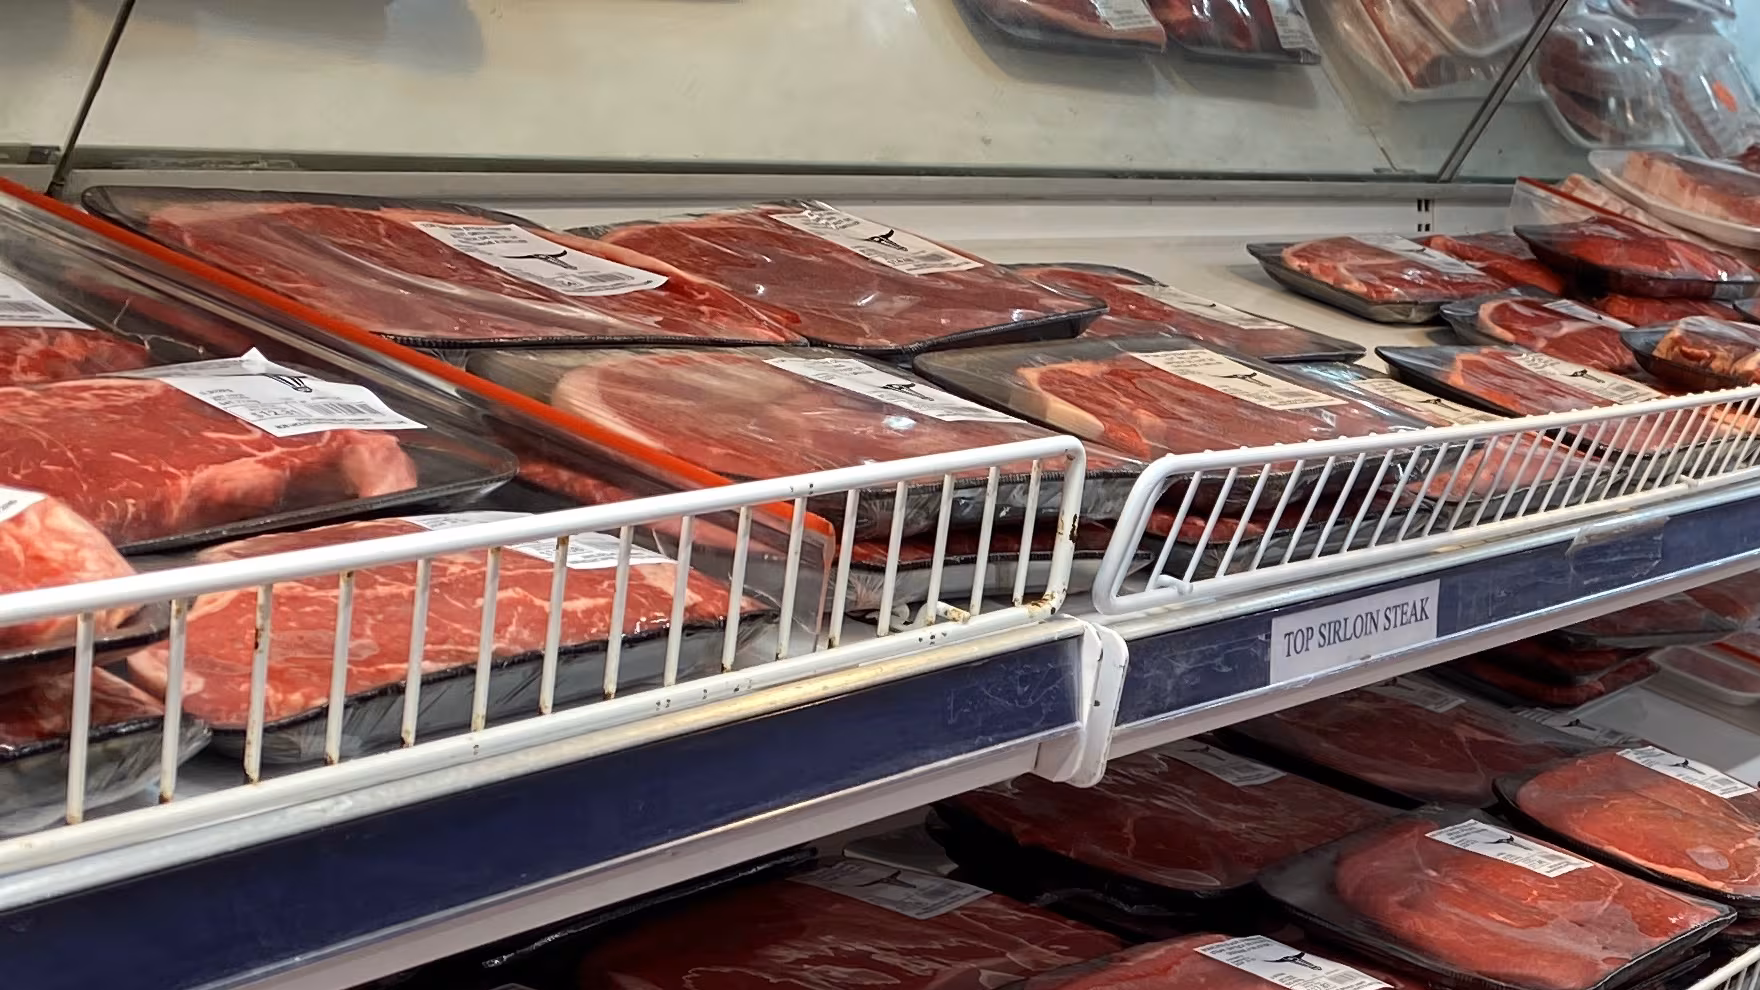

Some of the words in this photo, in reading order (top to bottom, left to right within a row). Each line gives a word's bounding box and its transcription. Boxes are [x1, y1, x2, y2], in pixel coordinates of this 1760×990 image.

[1284, 626, 1314, 658] TOP
[1318, 609, 1380, 648] SIRLOIN
[1383, 596, 1430, 632] STEAK
